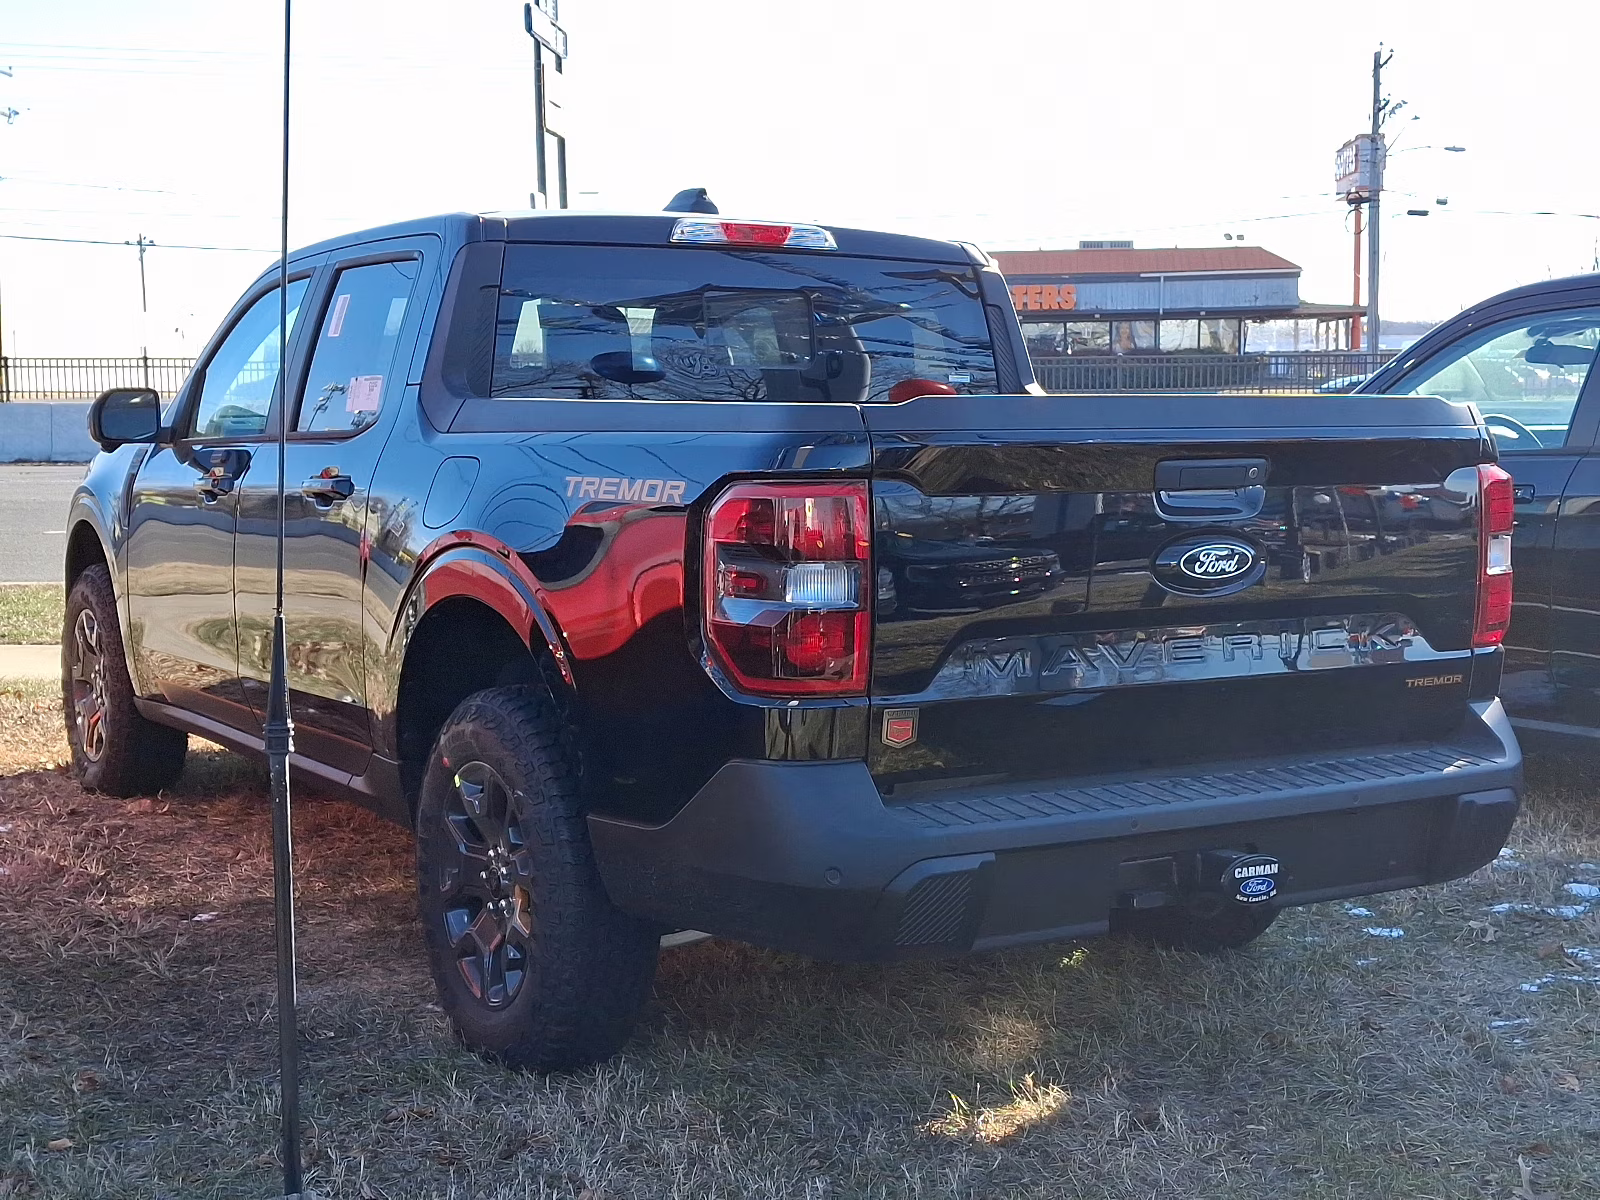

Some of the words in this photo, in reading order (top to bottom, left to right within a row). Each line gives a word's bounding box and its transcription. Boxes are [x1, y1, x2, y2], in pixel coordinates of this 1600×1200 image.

[565, 476, 686, 504] TREMOR
[1194, 548, 1239, 574] Ford
[973, 622, 1412, 679] MAVERICK
[1405, 674, 1463, 688] TREMOR
[1234, 863, 1279, 878] CARMAN
[1246, 879, 1268, 892] Ford
